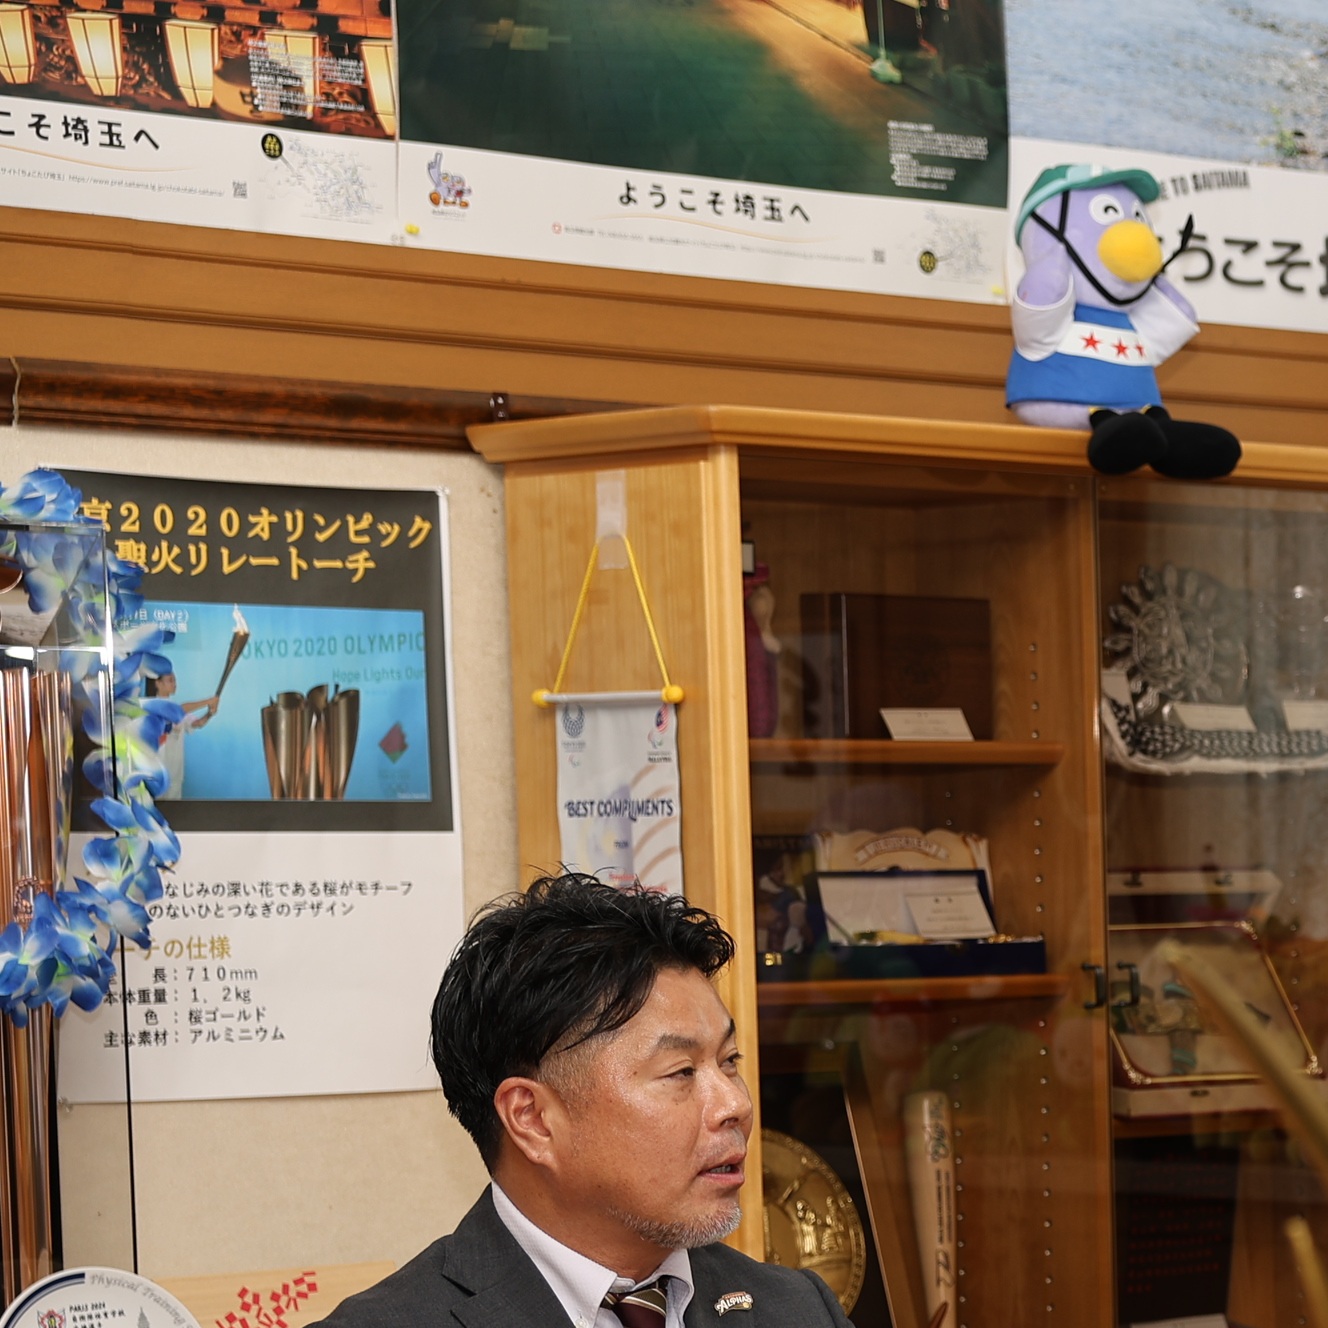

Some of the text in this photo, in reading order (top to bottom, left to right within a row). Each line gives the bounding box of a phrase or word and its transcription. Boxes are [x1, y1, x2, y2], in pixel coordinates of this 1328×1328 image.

[618, 179, 811, 223] ようこそ埼玉へ
[114, 538, 376, 583] 聖火リレートーチ
[242, 639, 289, 660] OKYO
[292, 637, 338, 657] 2020
[164, 880, 413, 899] なじみの深い花である桜がモチーフ
[149, 902, 355, 919] のないひとつなぎのデザイン
[91, 1273, 142, 1293] Physical
[142, 1287, 187, 1327] Training
[717, 1294, 752, 1313] ALPHAS
